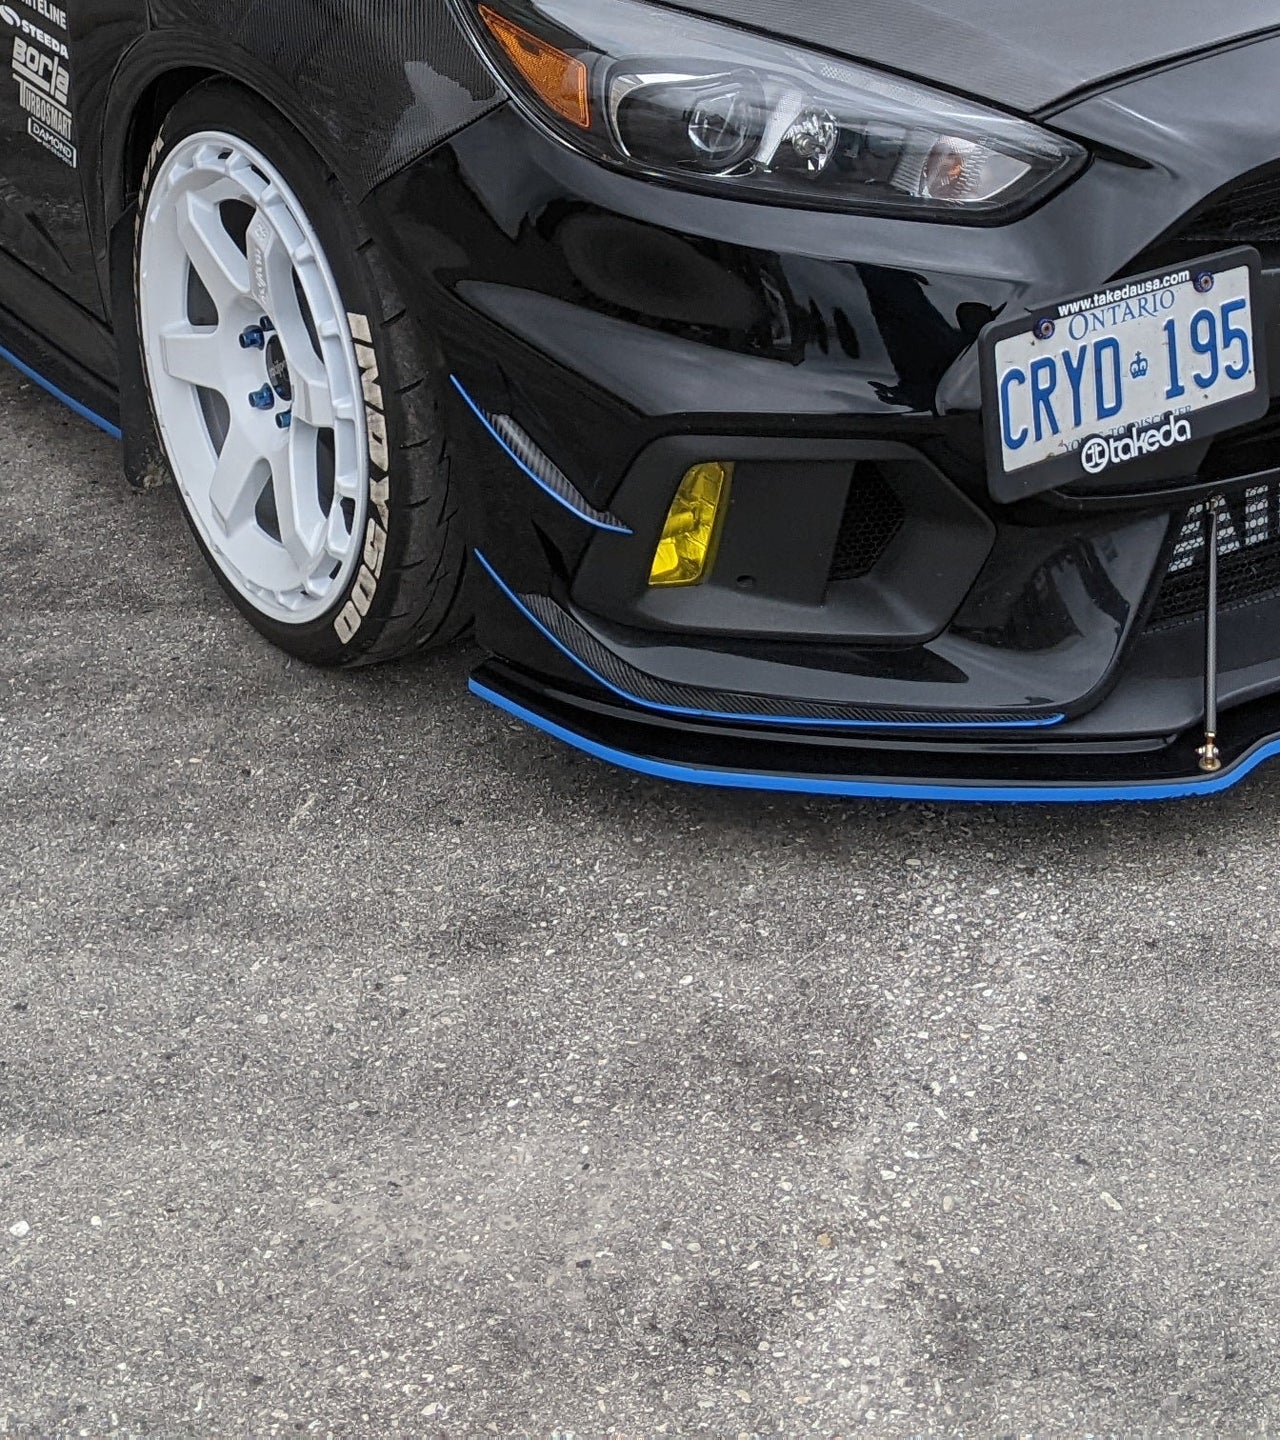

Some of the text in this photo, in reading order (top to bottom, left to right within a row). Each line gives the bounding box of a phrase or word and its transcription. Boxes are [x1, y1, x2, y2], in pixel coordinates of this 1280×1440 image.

[21, 19, 69, 60] STEEDA
[13, 72, 72, 141] TURBOSMART
[32, 122, 73, 158] DAMOND
[1058, 270, 1190, 317] www.takedausa.com
[1068, 289, 1175, 340] ONTARIO
[1000, 298, 1250, 450] CRYD 195
[1109, 414, 1192, 463] takeda
[333, 517, 388, 645] 500
